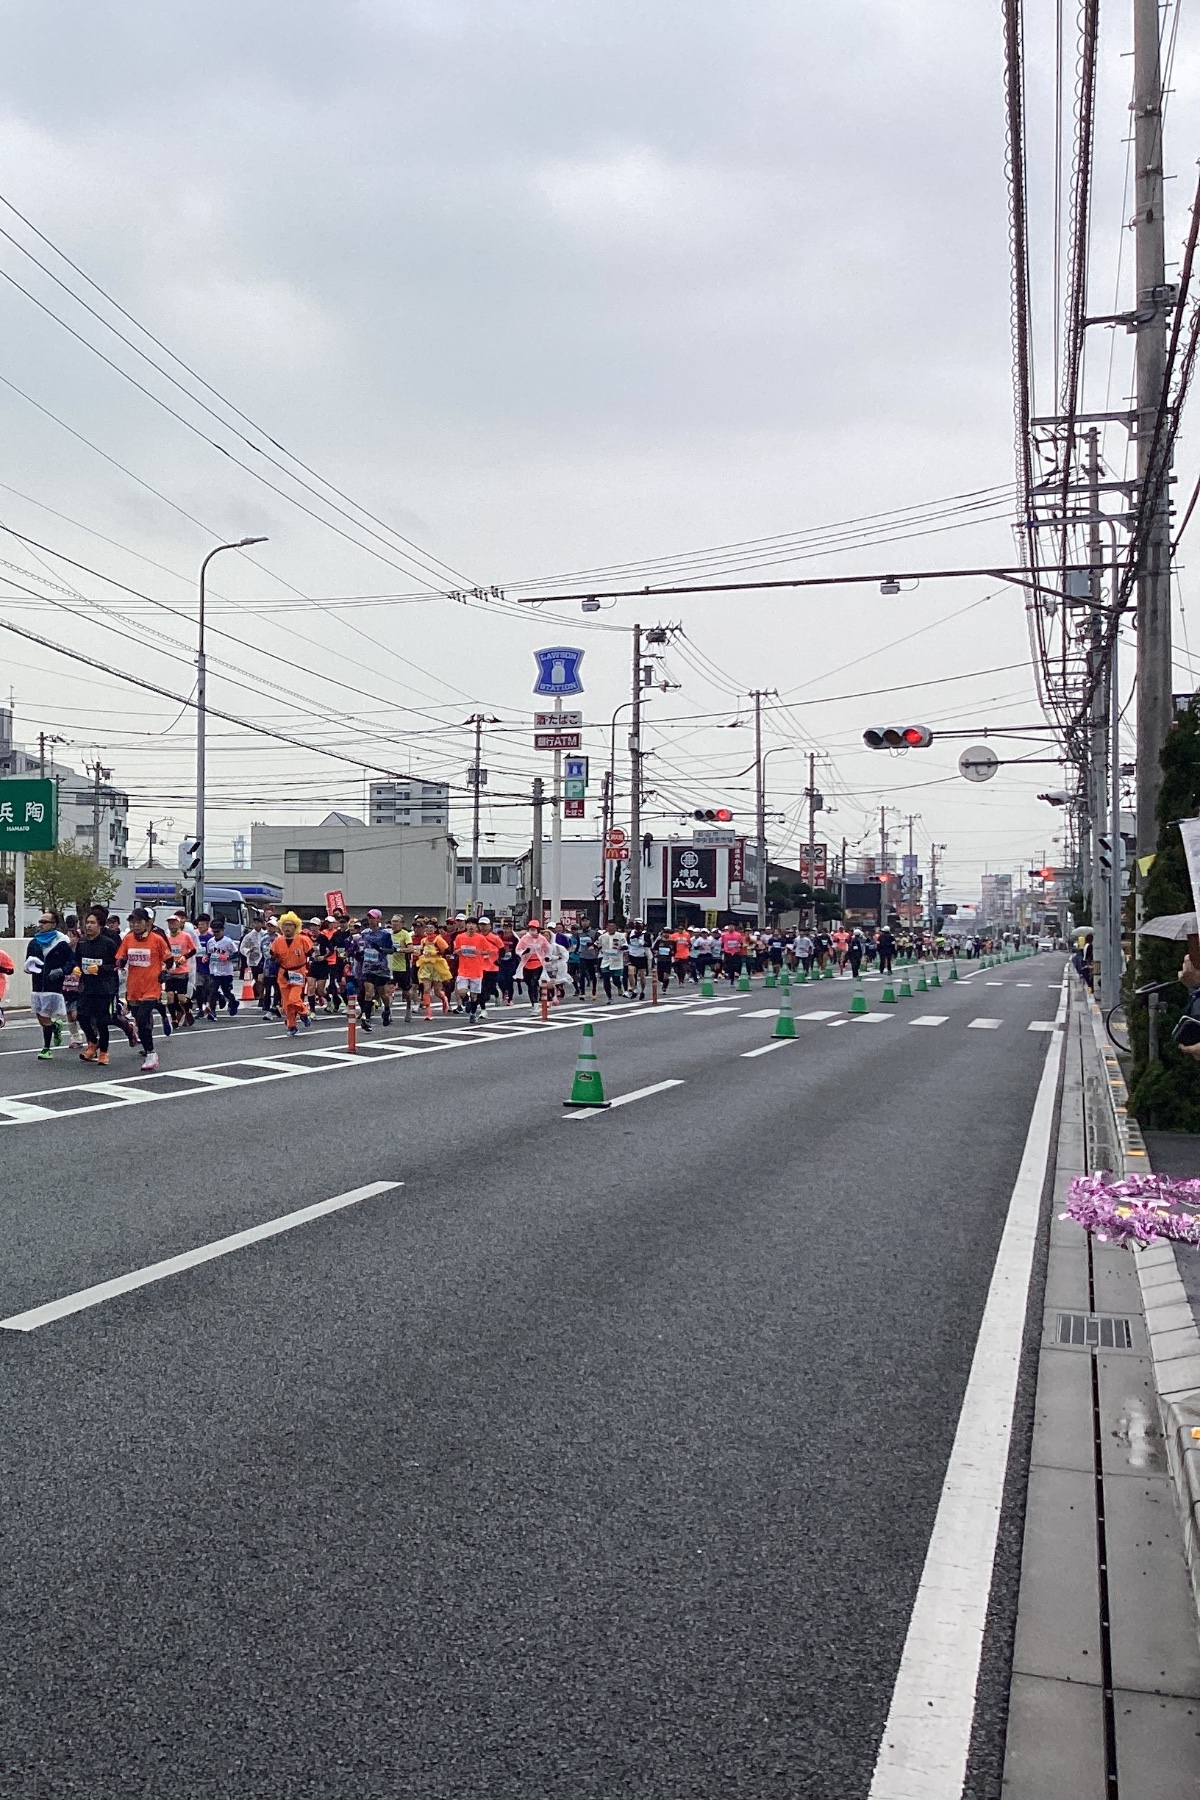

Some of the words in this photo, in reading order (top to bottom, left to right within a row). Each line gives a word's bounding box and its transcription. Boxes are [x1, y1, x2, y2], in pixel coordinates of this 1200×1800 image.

[540, 652, 577, 661] LAWSON
[540, 682, 577, 691] STATION
[672, 877, 708, 889] かもん
